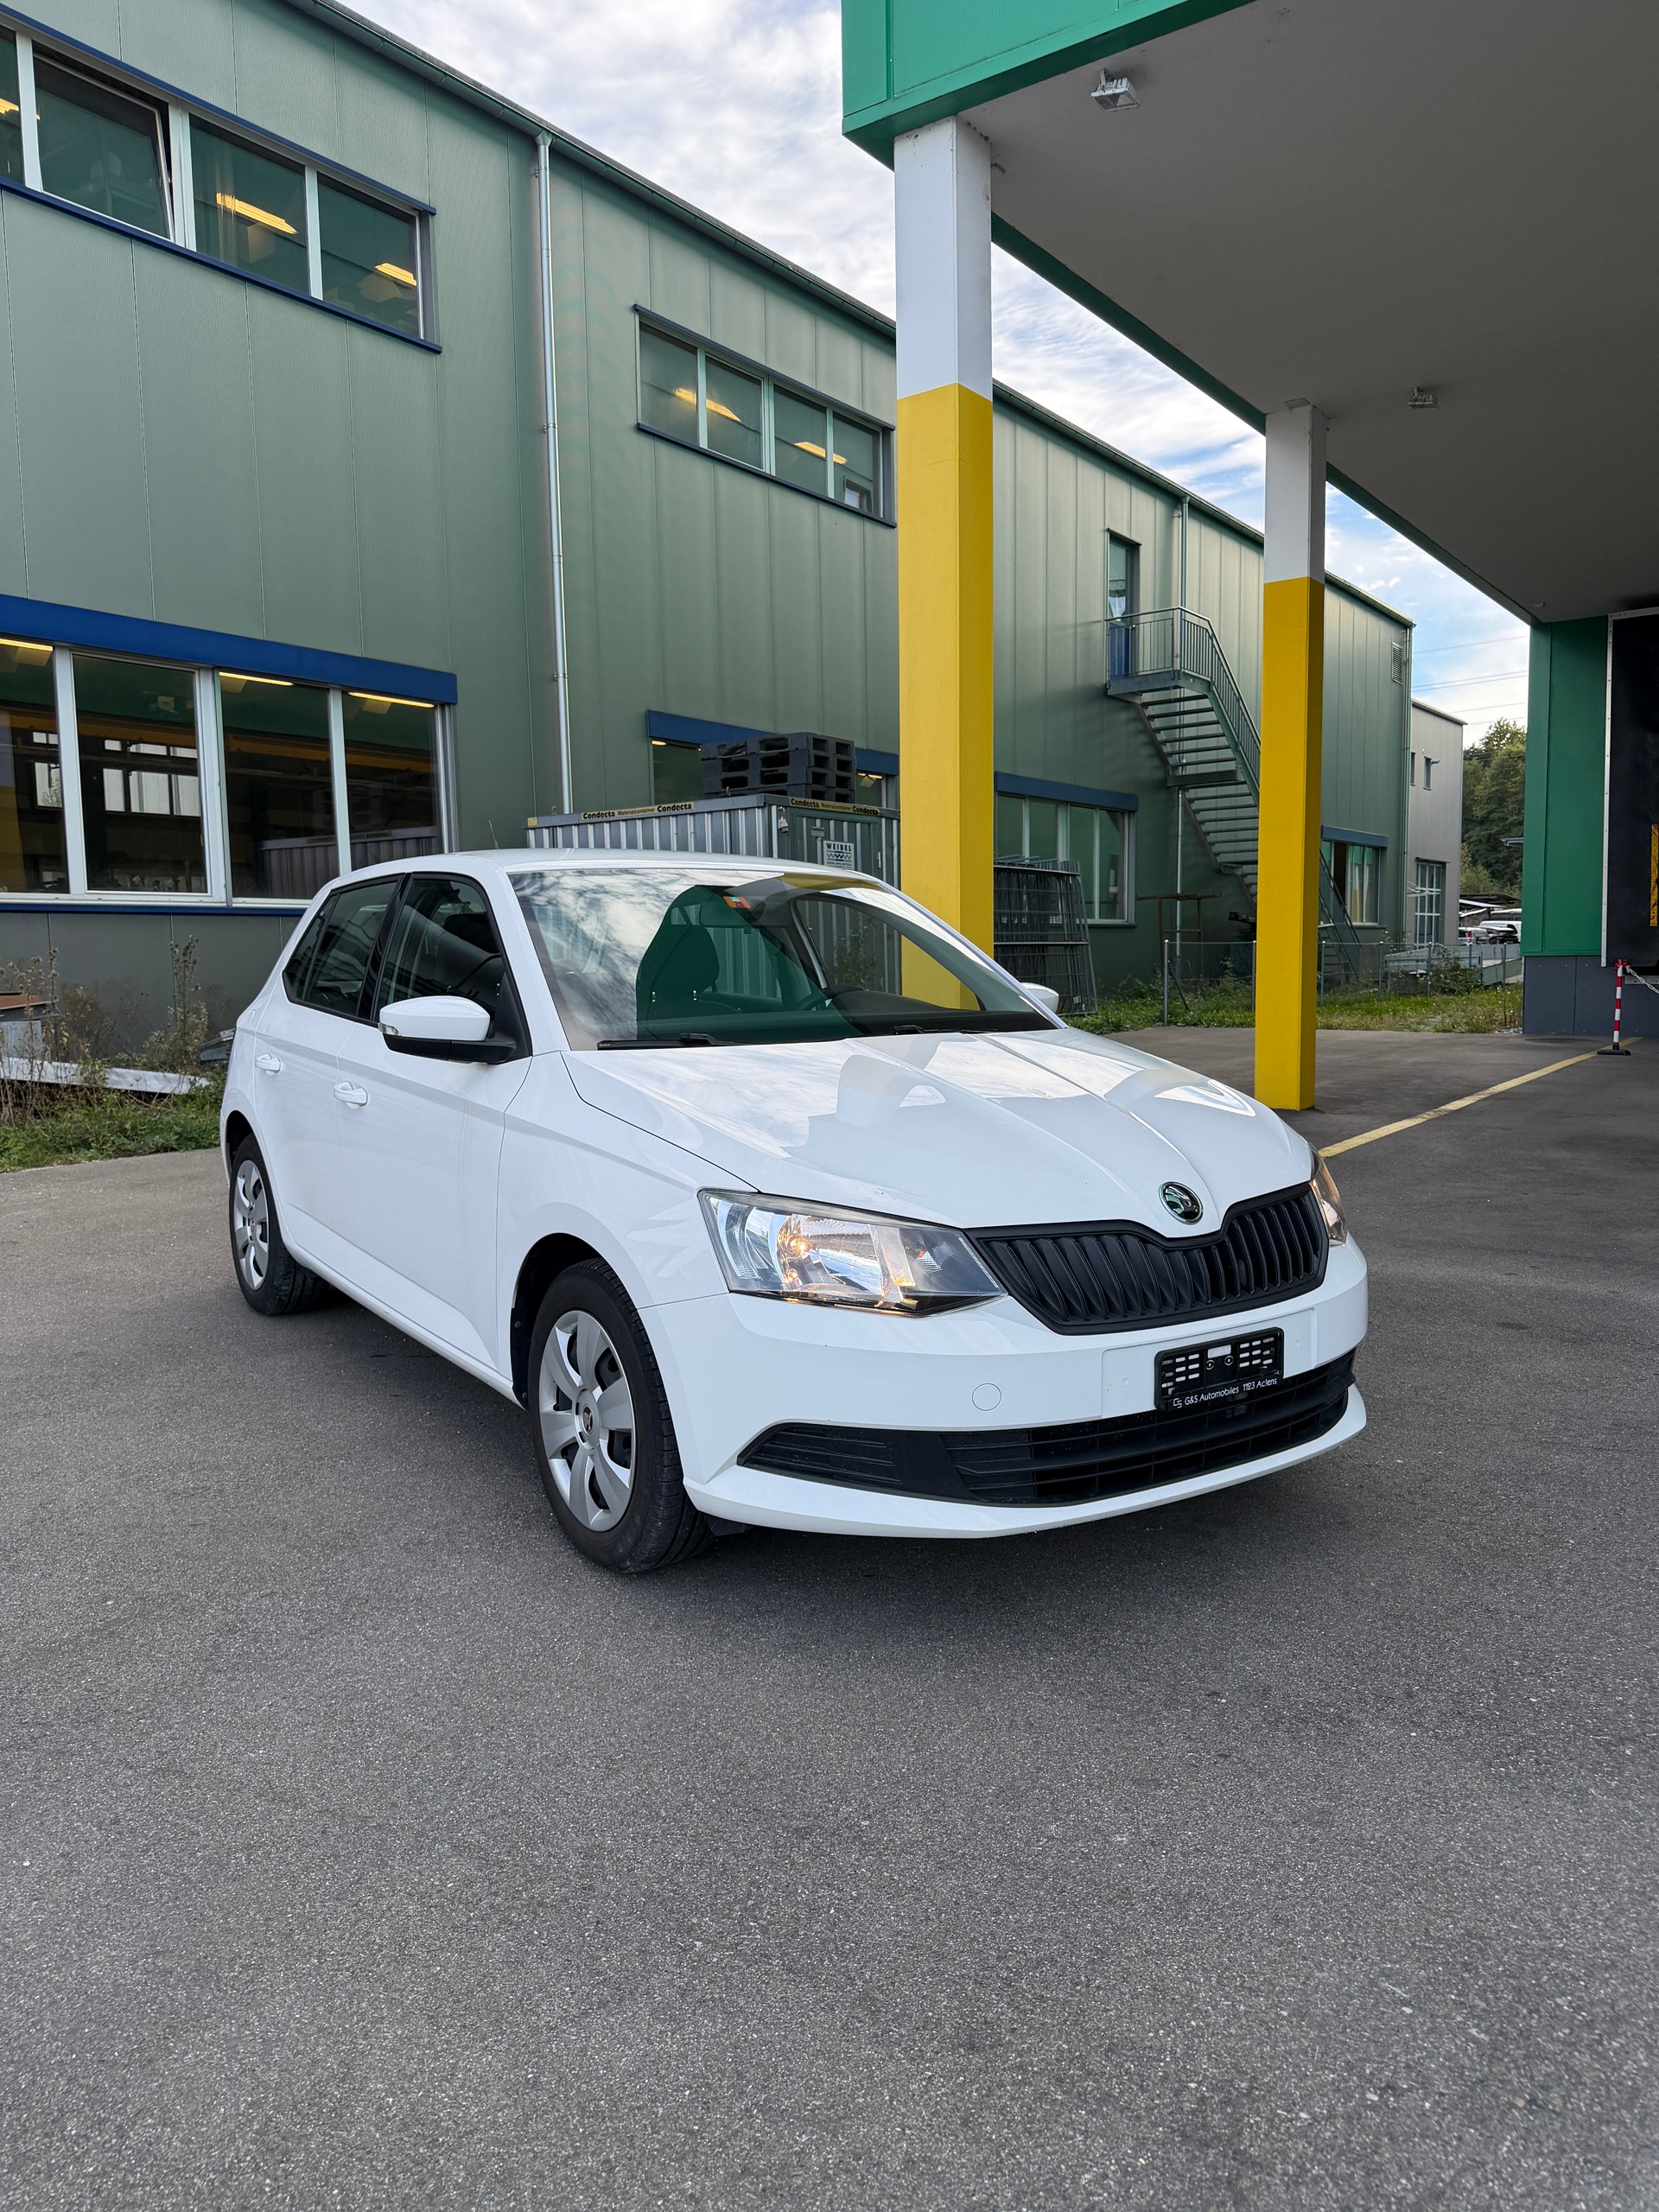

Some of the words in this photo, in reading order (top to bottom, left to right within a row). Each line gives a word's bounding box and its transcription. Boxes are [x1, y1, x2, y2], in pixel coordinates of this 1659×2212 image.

[582, 810, 615, 819] Condecta
[657, 803, 692, 812] Condecta
[791, 798, 819, 808] Condecta
[852, 805, 879, 815] Condecta
[826, 842, 851, 852] WEIBEL
[1185, 1395, 1198, 1406] G&S
[1199, 1386, 1239, 1402] Automobiles
[1256, 1378, 1277, 1389] Aclens
